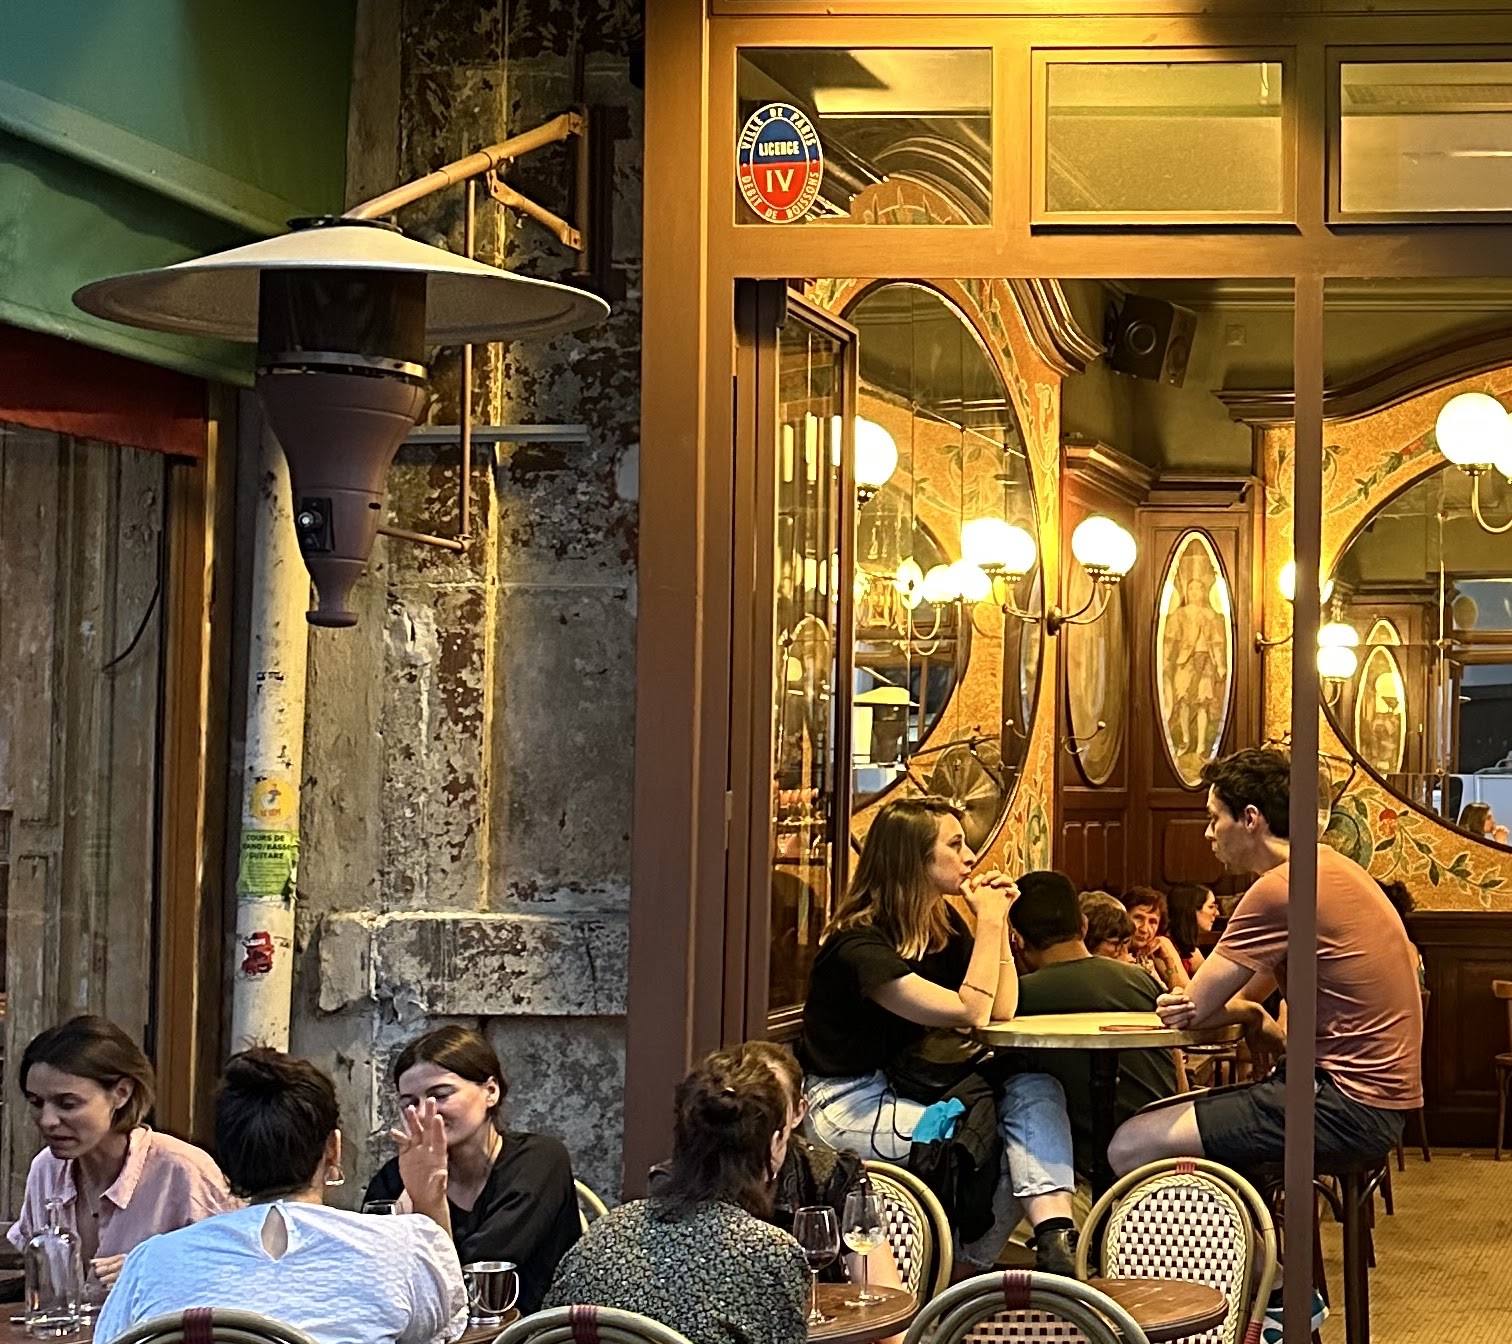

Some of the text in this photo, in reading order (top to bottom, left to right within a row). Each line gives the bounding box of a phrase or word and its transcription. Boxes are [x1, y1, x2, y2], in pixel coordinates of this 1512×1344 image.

[741, 107, 817, 150] VILLE DE PARIS
[758, 140, 800, 157] LICENCE
[766, 168, 795, 193] IV
[765, 207, 779, 220] DE
[785, 171, 819, 219] BOISSONS
[246, 834, 285, 842] COURS DE
